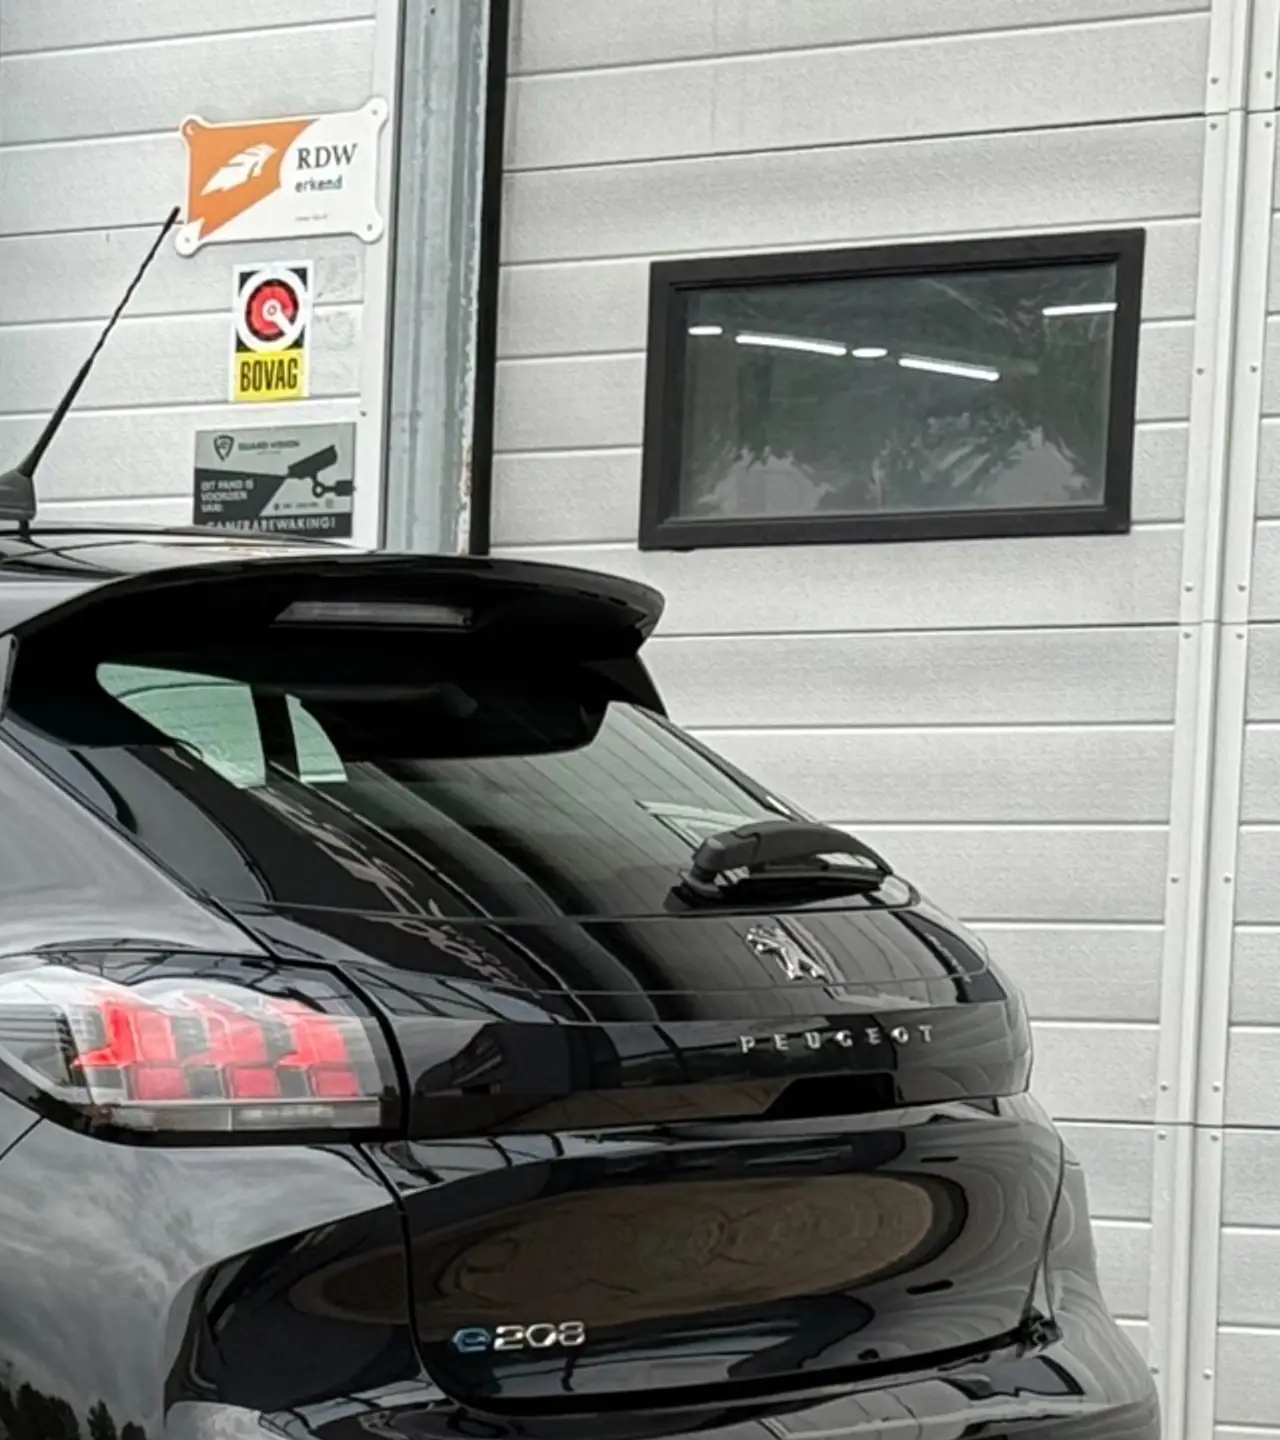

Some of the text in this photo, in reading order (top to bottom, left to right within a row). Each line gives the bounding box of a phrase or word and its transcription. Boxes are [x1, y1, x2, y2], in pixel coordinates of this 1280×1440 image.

[297, 143, 358, 170] RDW
[295, 174, 343, 193] erkend
[240, 358, 298, 392] BOVAG
[740, 1025, 933, 1053] PEUGEOT
